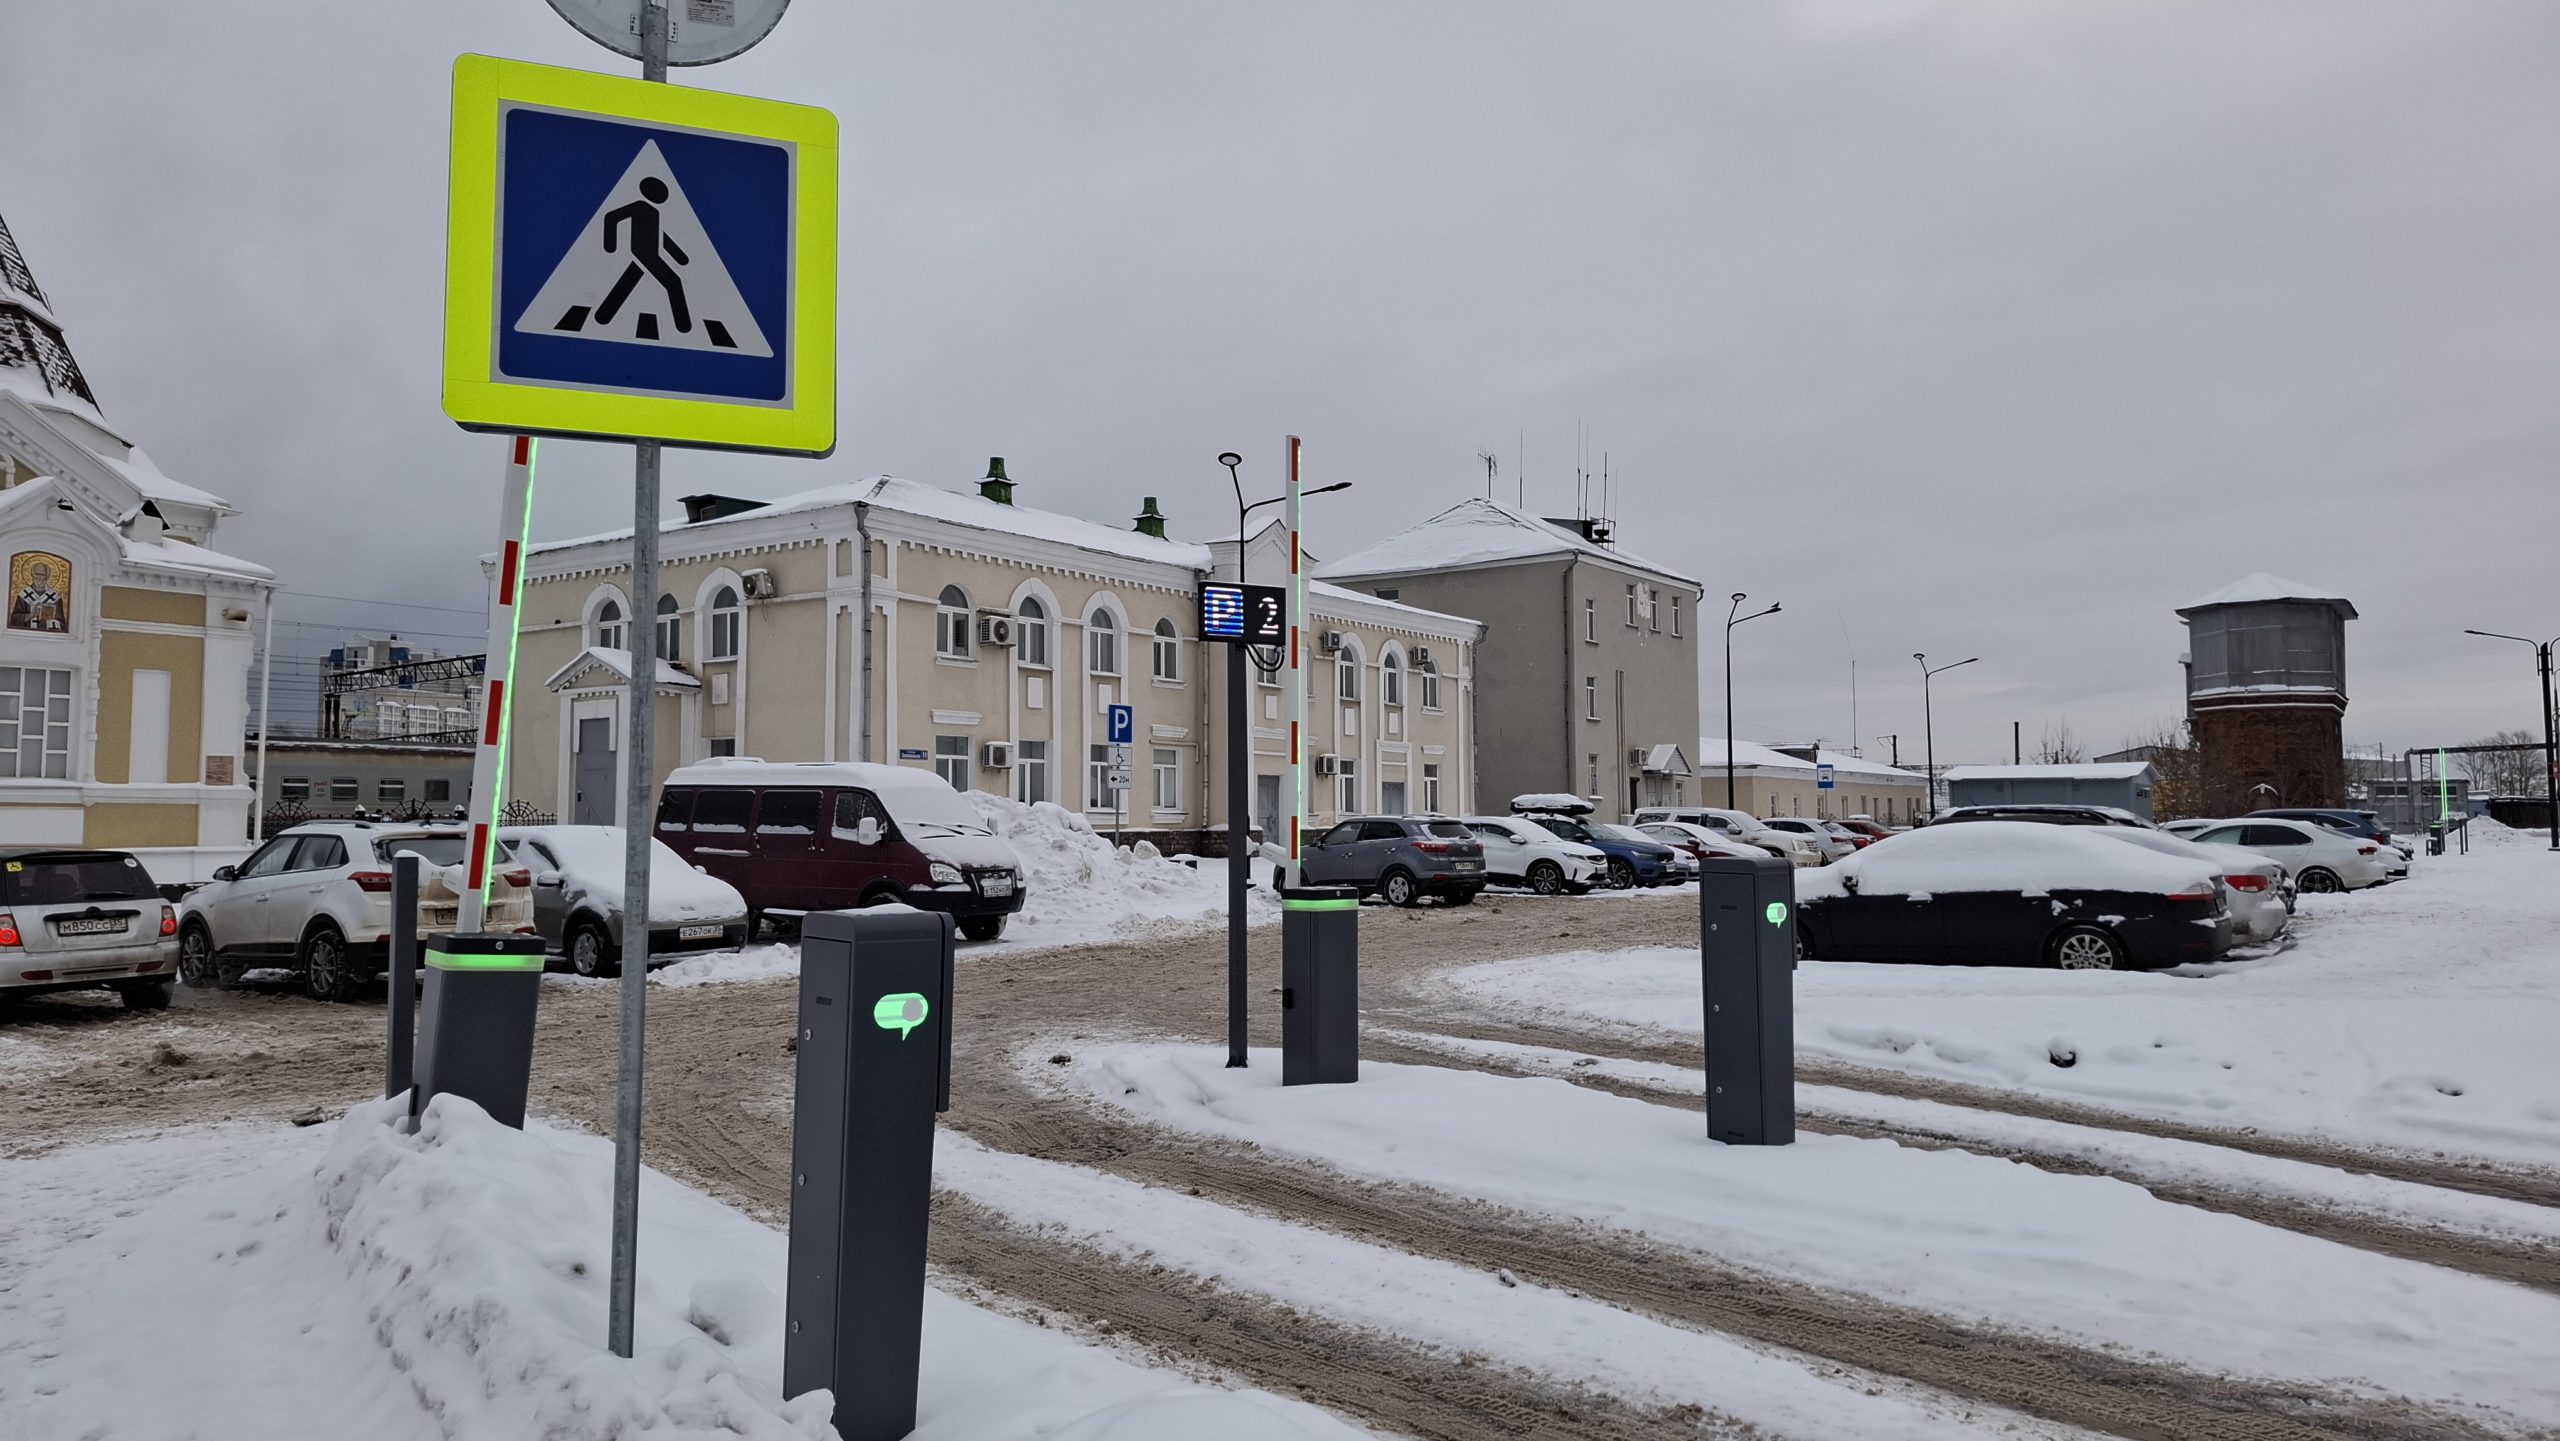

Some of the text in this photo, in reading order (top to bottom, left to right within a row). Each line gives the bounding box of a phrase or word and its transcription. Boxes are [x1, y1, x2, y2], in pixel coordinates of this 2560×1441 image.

[1258, 596, 1279, 635] 2
[1115, 709, 1129, 739] P
[1118, 775, 1130, 784] 20м
